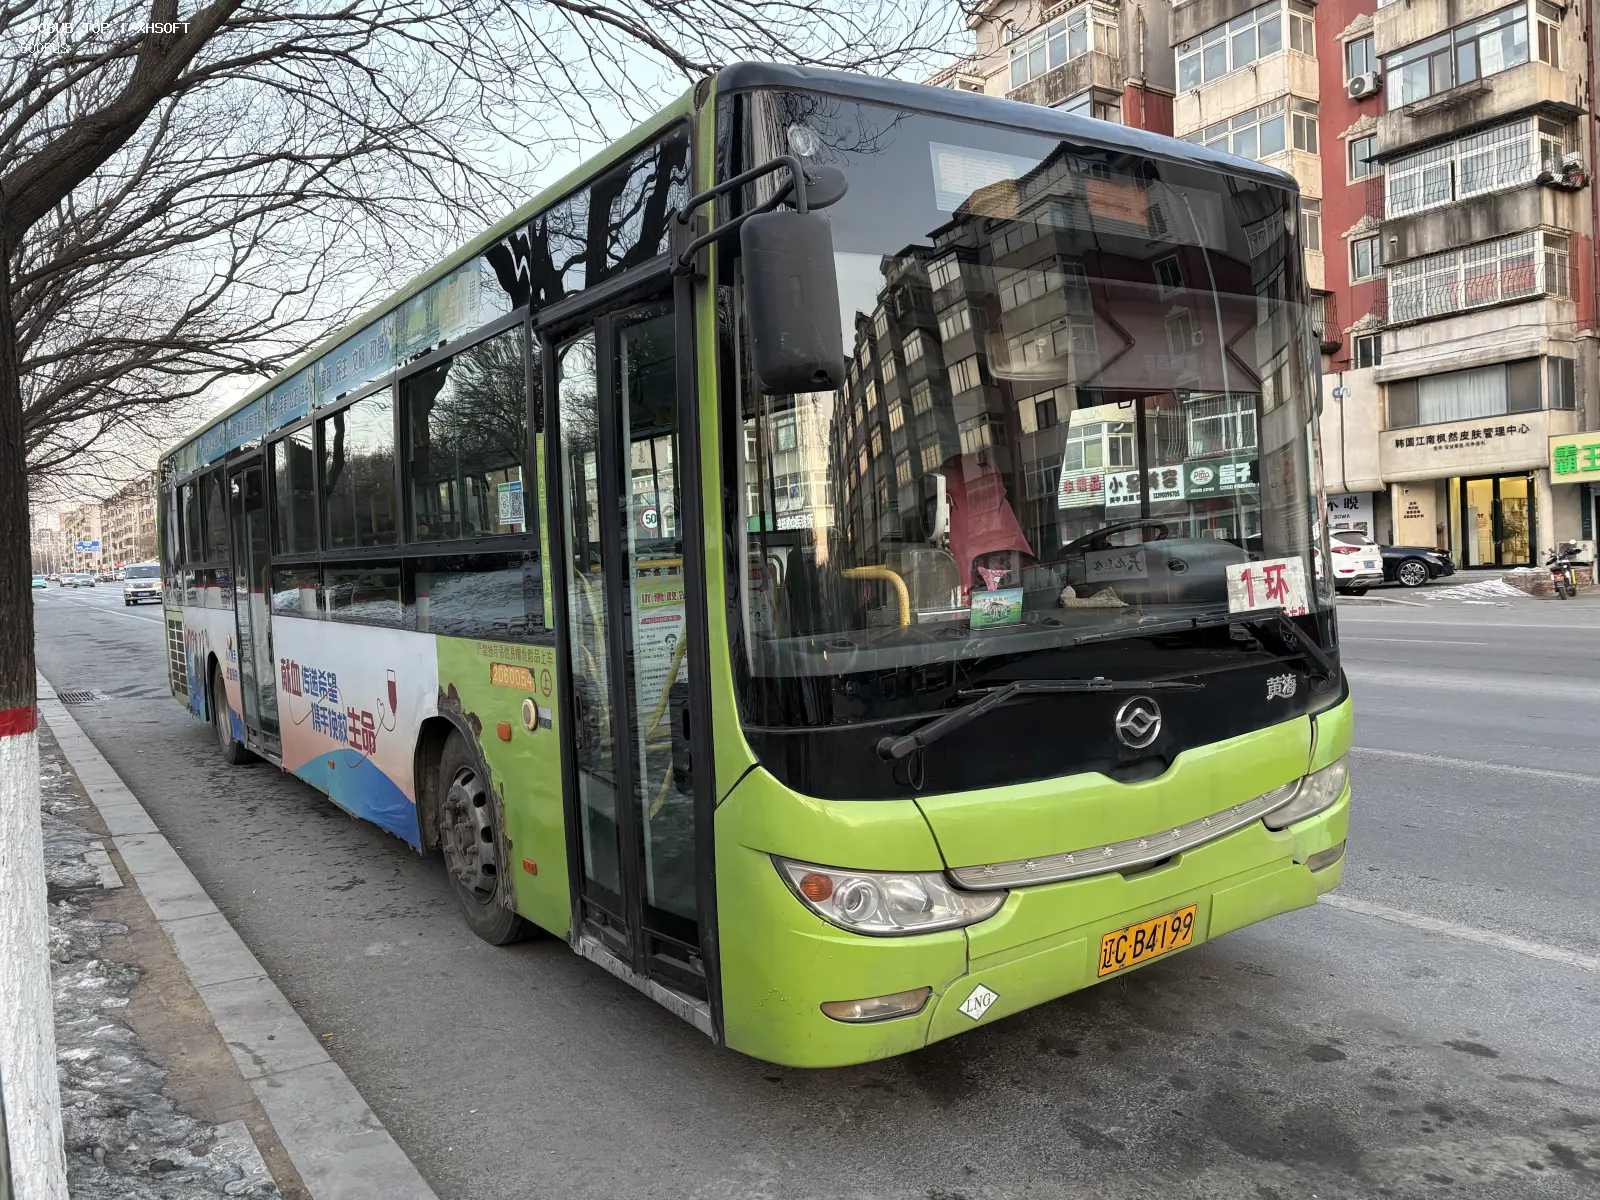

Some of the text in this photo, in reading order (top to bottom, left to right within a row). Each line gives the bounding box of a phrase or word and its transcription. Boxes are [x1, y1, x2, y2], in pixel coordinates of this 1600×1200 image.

[1394, 423, 1530, 449] 韩国江南枫然皮肤管理中心
[645, 513, 657, 525] 50
[1240, 563, 1290, 607] 1环
[493, 666, 533, 687] 2060054
[965, 992, 992, 1014] LNG
